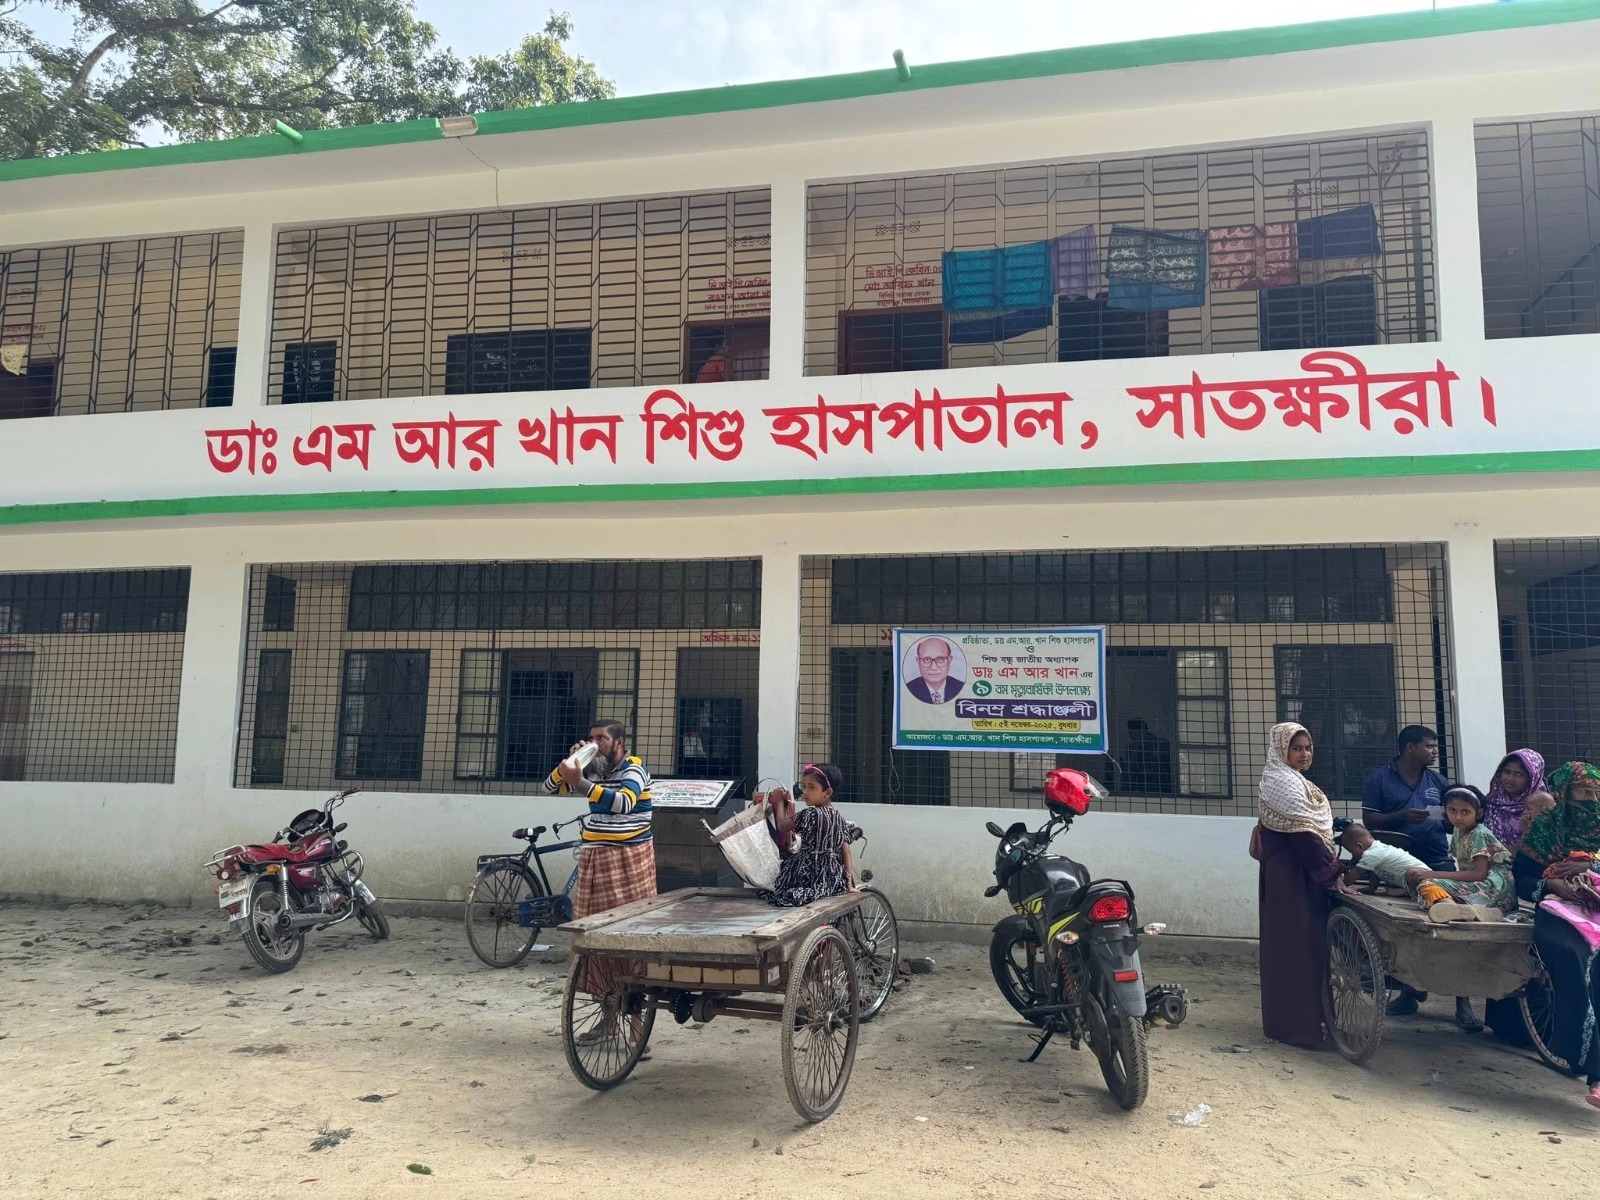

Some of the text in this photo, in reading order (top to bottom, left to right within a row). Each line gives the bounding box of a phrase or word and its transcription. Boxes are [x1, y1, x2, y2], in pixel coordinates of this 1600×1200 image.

[207, 422, 278, 475] ডাঃ
[293, 424, 376, 473] এম
[394, 411, 503, 473] আর
[518, 406, 625, 466] খান
[640, 389, 746, 465] শিশু
[994, 637, 1004, 645] ডাঃ
[1034, 637, 1047, 645] খান
[1048, 635, 1061, 645] শিশু
[1063, 636, 1095, 645] হাসপাতাল
[1025, 645, 1035, 653] ও
[982, 654, 1079, 665] শিশু বন্ধু জাতীয় অধ্যাপক
[972, 666, 993, 679] ডাঃ
[997, 666, 1019, 679] এম
[1023, 666, 1050, 679] আর
[1054, 666, 1080, 679] খান
[957, 699, 1094, 717] বিনম্র শ্রদ্ধাঞ্জলী
[974, 719, 993, 728] তারিখ
[1058, 721, 1078, 730] বুধবার
